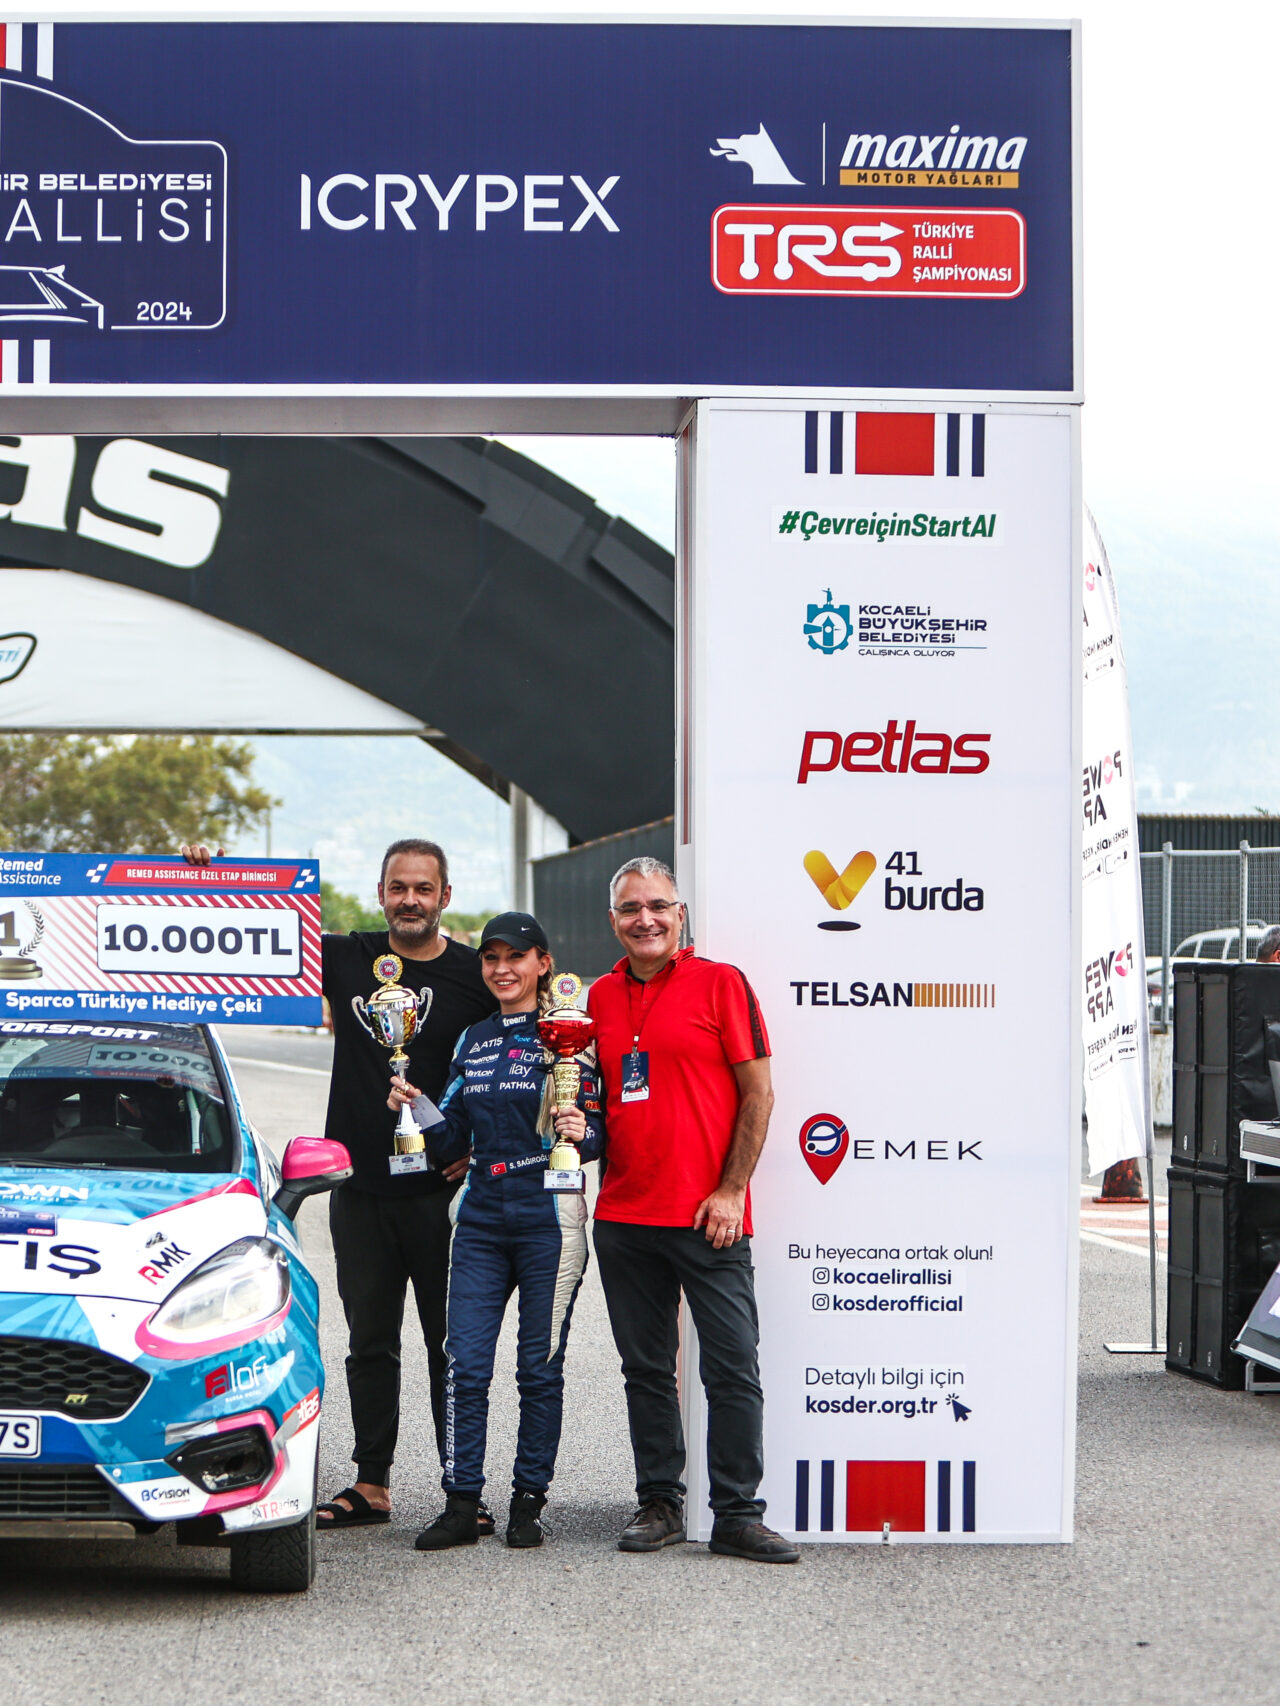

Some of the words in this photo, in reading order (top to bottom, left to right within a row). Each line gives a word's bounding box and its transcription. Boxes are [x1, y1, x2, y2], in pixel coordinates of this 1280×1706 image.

[838, 124, 1029, 170] maxima
[857, 172, 916, 185] MOTOR
[925, 171, 1003, 187] YAĞLARI
[300, 172, 621, 233] ICRYPEX
[912, 222, 974, 240] TÜRKİYE
[724, 221, 905, 282] TRS
[913, 242, 953, 260] RALLİ
[912, 263, 1012, 284] ŞAMPİYONASI
[136, 302, 192, 322] 2024
[858, 648, 910, 657] ÇALIŞINCA
[913, 649, 956, 657] OLUYOR
[797, 720, 992, 784] petlas
[884, 851, 923, 876] 41
[126, 869, 152, 880] REMED
[154, 869, 199, 880] ASSISTANCE
[201, 868, 220, 881] ÖZEL
[222, 871, 240, 881] ETAP
[242, 870, 277, 883] BİRİNCİSİ
[884, 877, 985, 911] burda
[104, 923, 293, 956] 10.000TL
[6, 991, 74, 1011] Sparco
[77, 992, 146, 1013] Türkiye
[152, 995, 217, 1014] Hediye
[222, 996, 262, 1017] Çeki
[789, 981, 914, 1007] TELSAN
[499, 1081, 537, 1091] PATHKA
[853, 1139, 984, 1161] EMEK
[137, 1241, 192, 1285] RMK
[787, 1244, 811, 1259] Bu
[815, 1244, 901, 1263] heyecana
[905, 1245, 949, 1260] ortak
[953, 1245, 994, 1260] olun!
[833, 1268, 952, 1285] kocaelirallisi
[832, 1294, 963, 1312] kosderofficial
[805, 1368, 876, 1389] Detaylı
[881, 1368, 924, 1389] bilgi
[930, 1368, 964, 1388] için
[805, 1395, 938, 1418] kosder.org.tr
